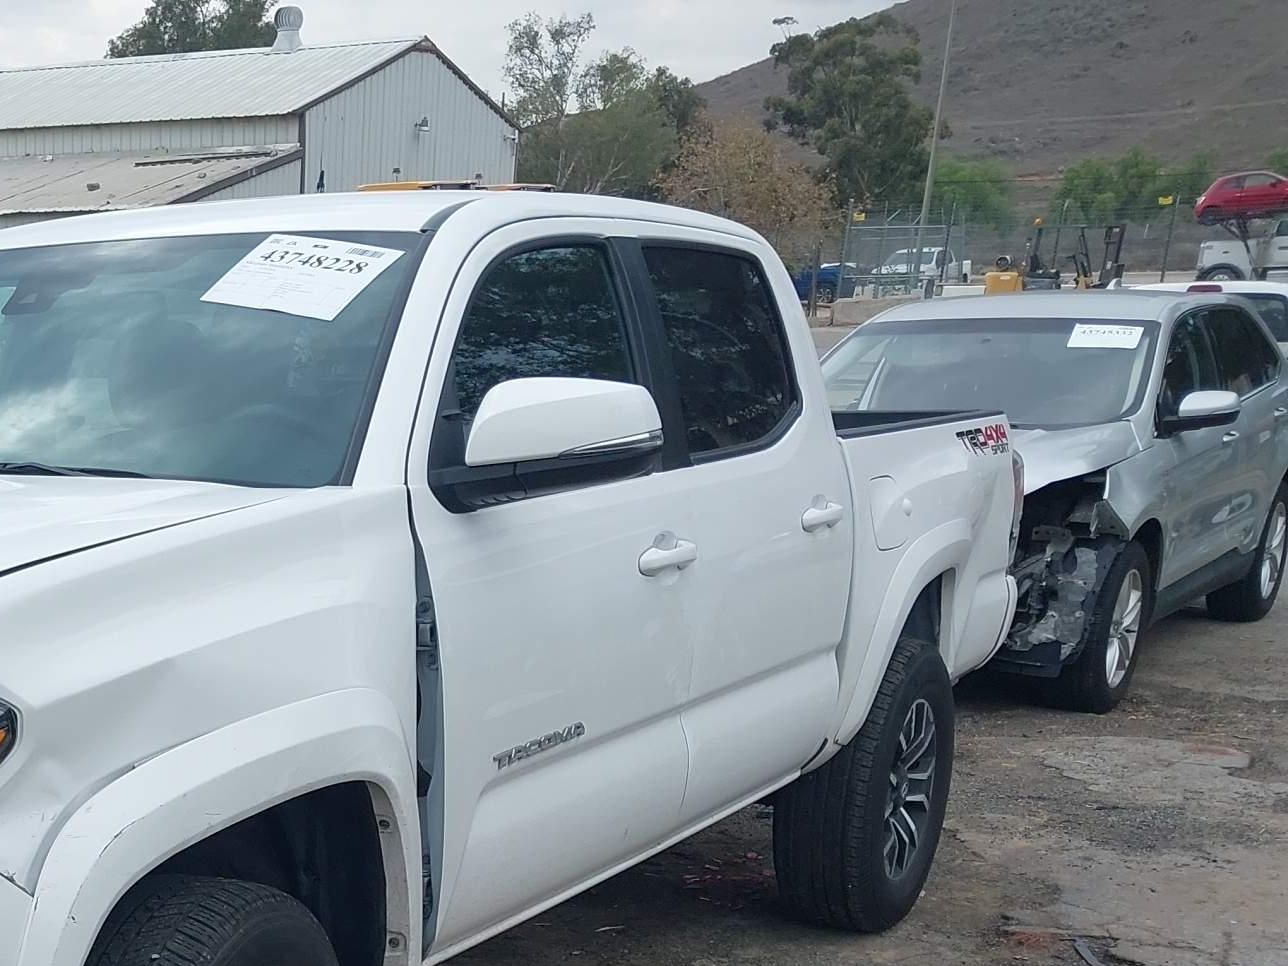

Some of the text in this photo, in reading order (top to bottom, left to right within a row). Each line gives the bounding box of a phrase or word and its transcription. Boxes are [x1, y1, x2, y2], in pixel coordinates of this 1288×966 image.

[260, 249, 370, 275] 43748228
[991, 443, 1010, 456] SPORT
[492, 721, 586, 770] TACOMA
